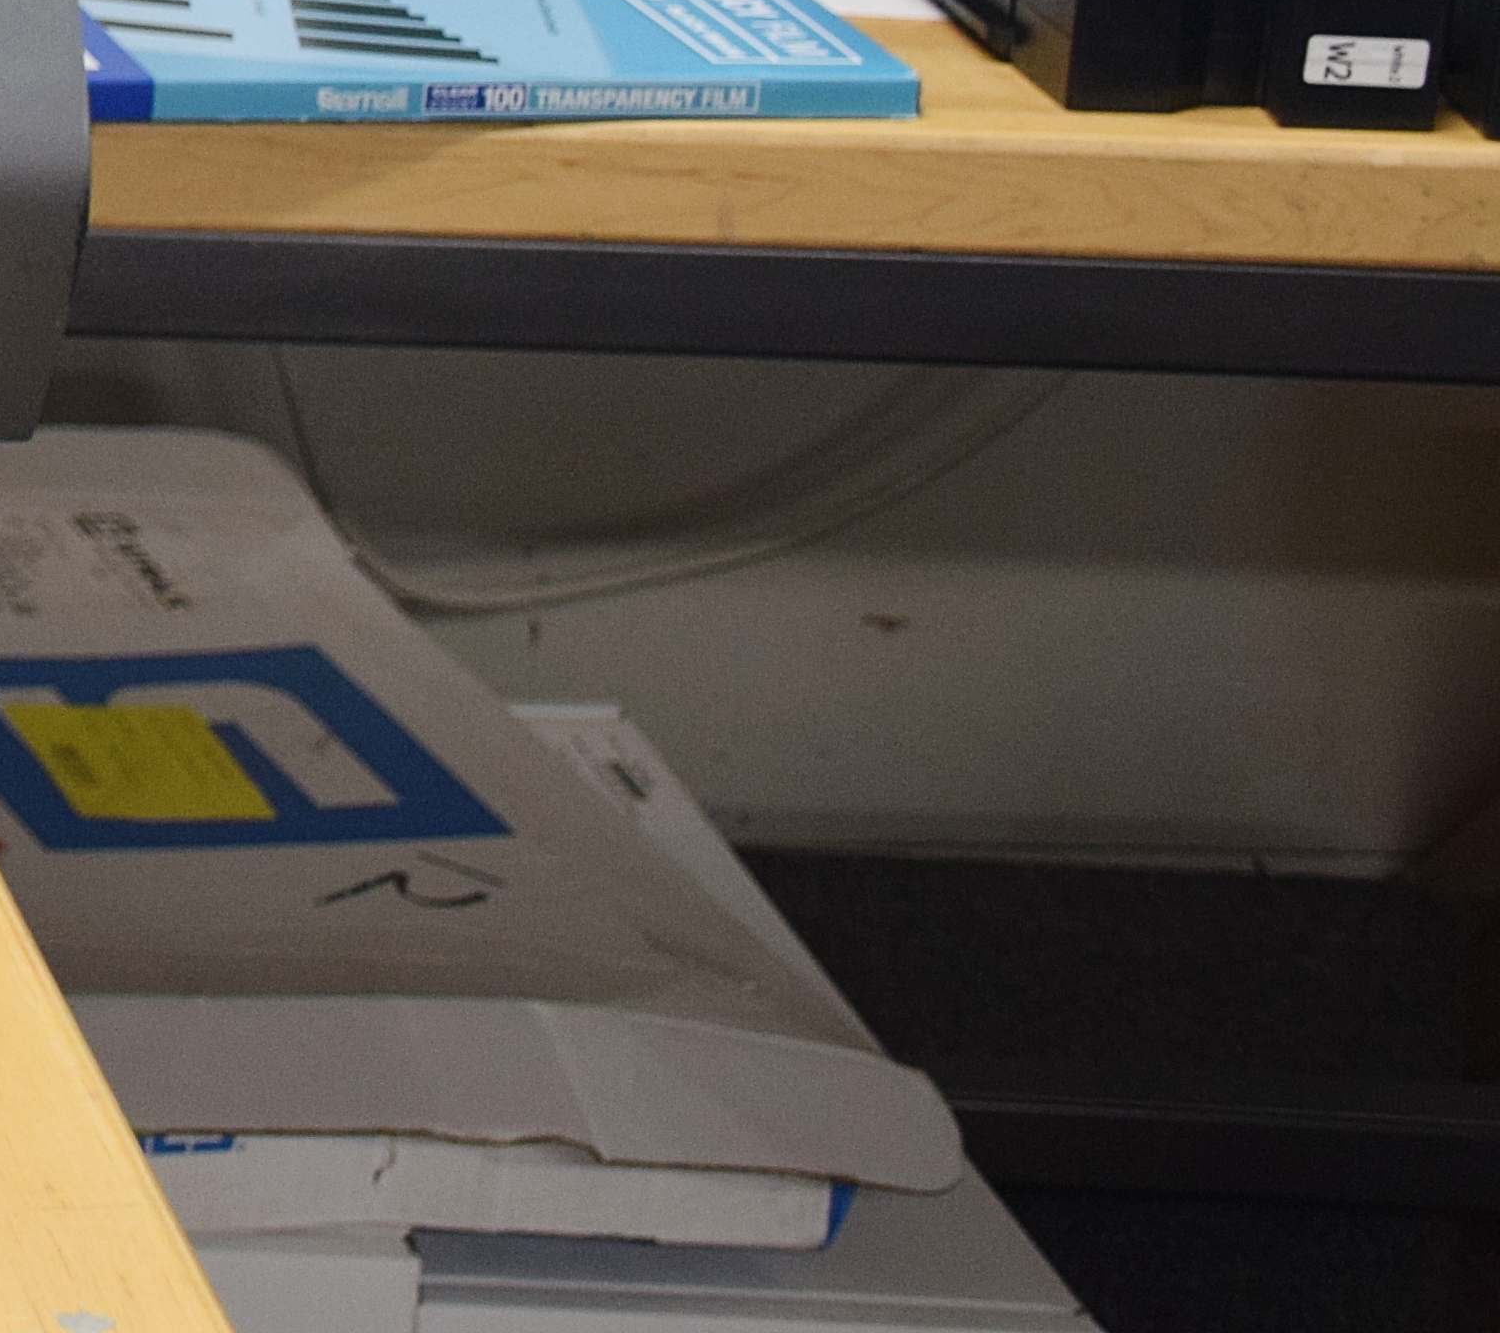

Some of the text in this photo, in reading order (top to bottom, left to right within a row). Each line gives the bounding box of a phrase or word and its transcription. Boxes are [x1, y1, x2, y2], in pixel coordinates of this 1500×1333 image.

[1324, 41, 1357, 81] W2
[486, 87, 525, 112] 100
[537, 86, 748, 110] TRANSPARENCY FILM
